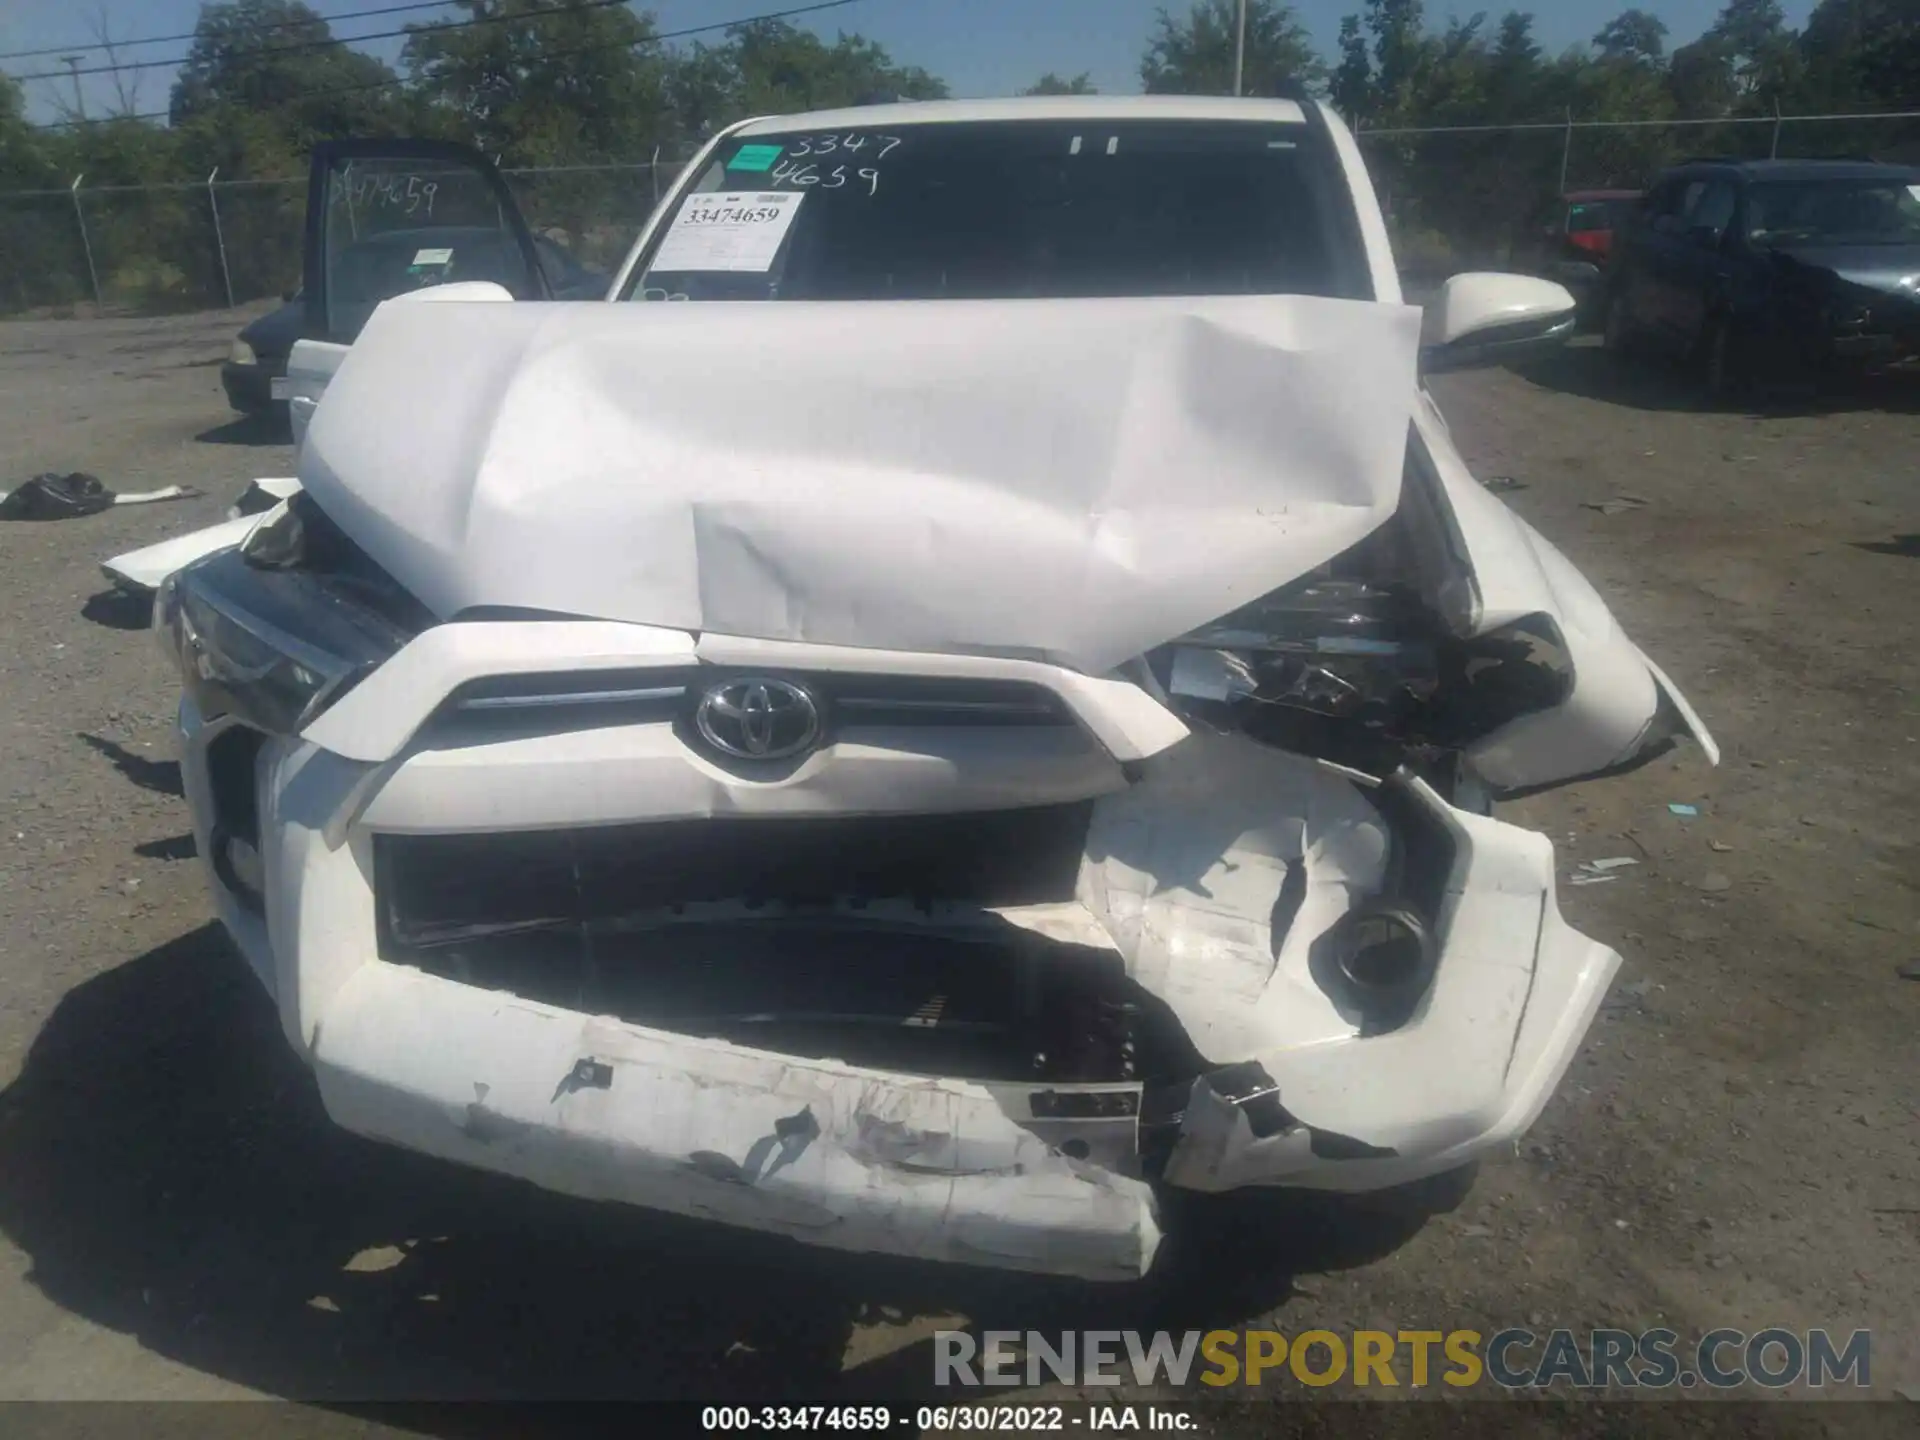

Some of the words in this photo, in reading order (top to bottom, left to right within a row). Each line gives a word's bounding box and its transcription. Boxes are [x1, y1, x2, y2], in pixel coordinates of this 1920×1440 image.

[789, 133, 901, 159] 3347
[771, 160, 880, 196] 4659
[684, 207, 780, 225] 33474659
